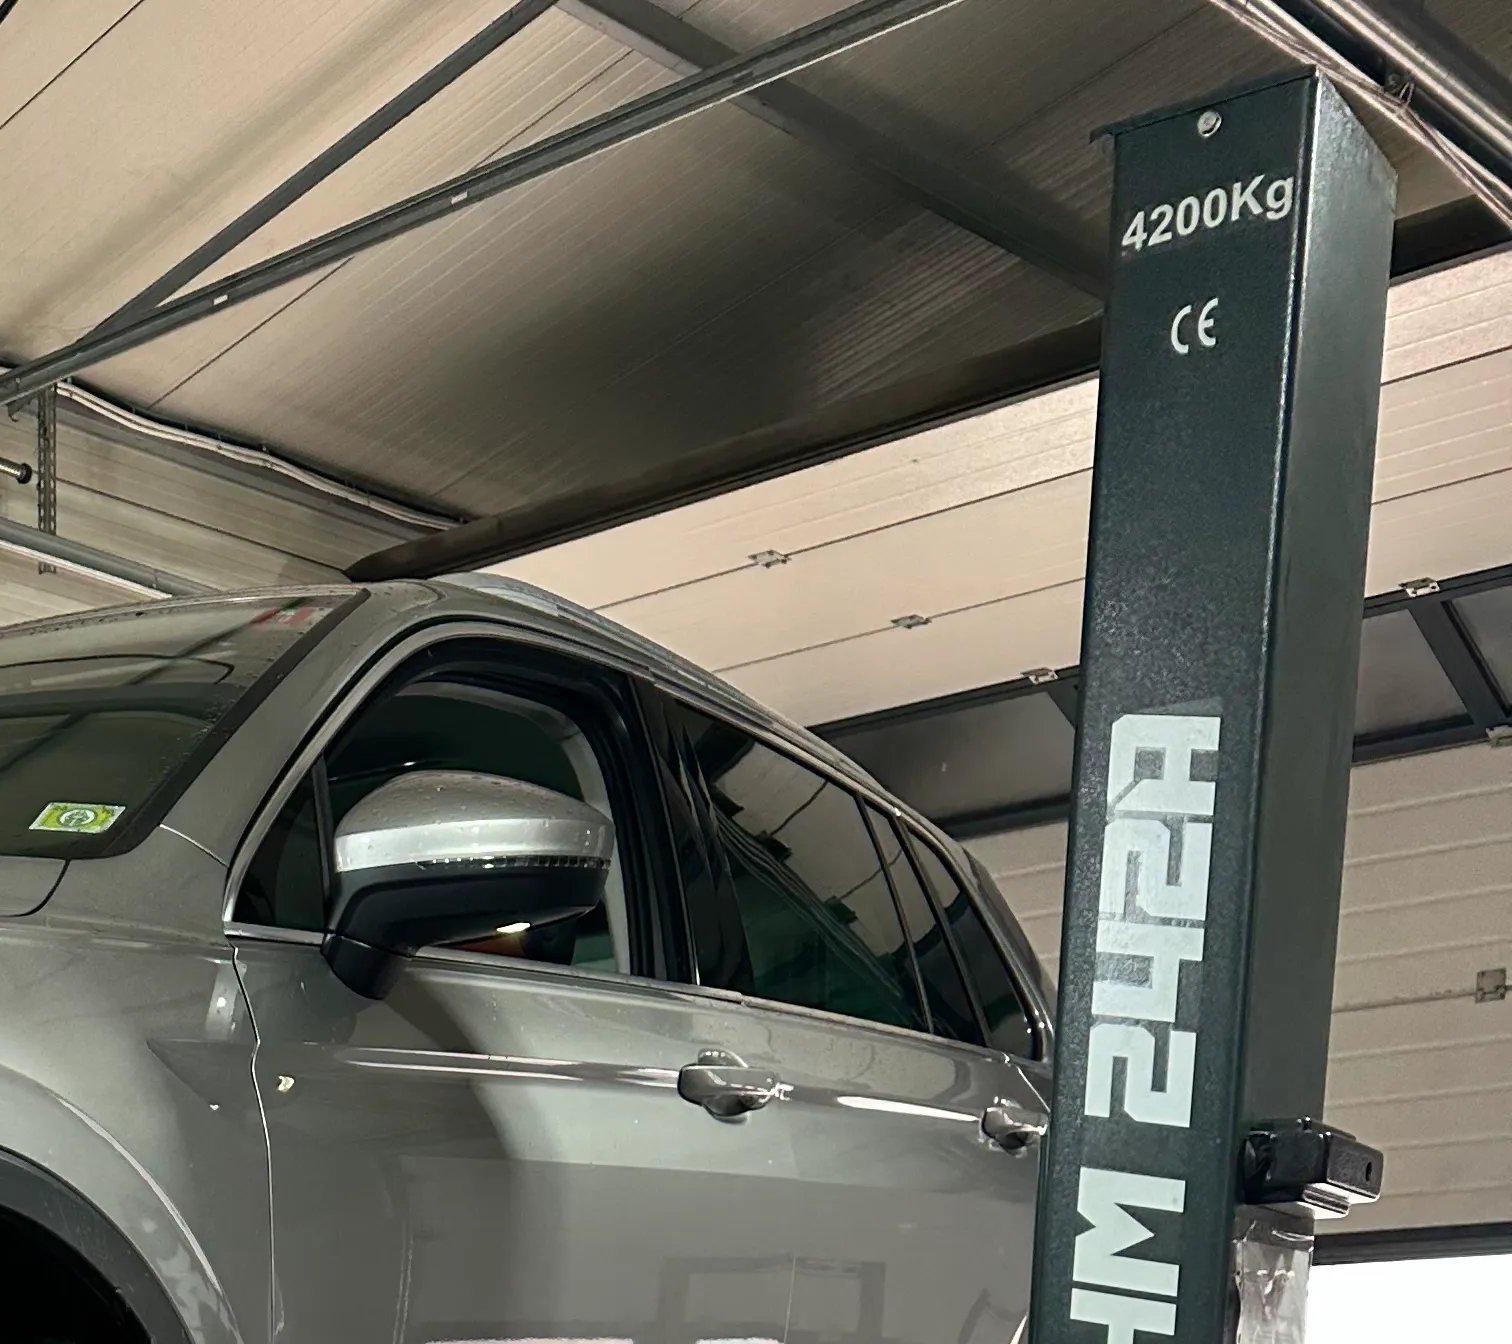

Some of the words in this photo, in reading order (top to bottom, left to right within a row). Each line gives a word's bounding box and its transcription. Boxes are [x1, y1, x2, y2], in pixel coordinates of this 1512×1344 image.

[1121, 173, 1295, 252] 4200Kg
[1170, 297, 1219, 355] CE
[1084, 712, 1222, 1128] 242A
